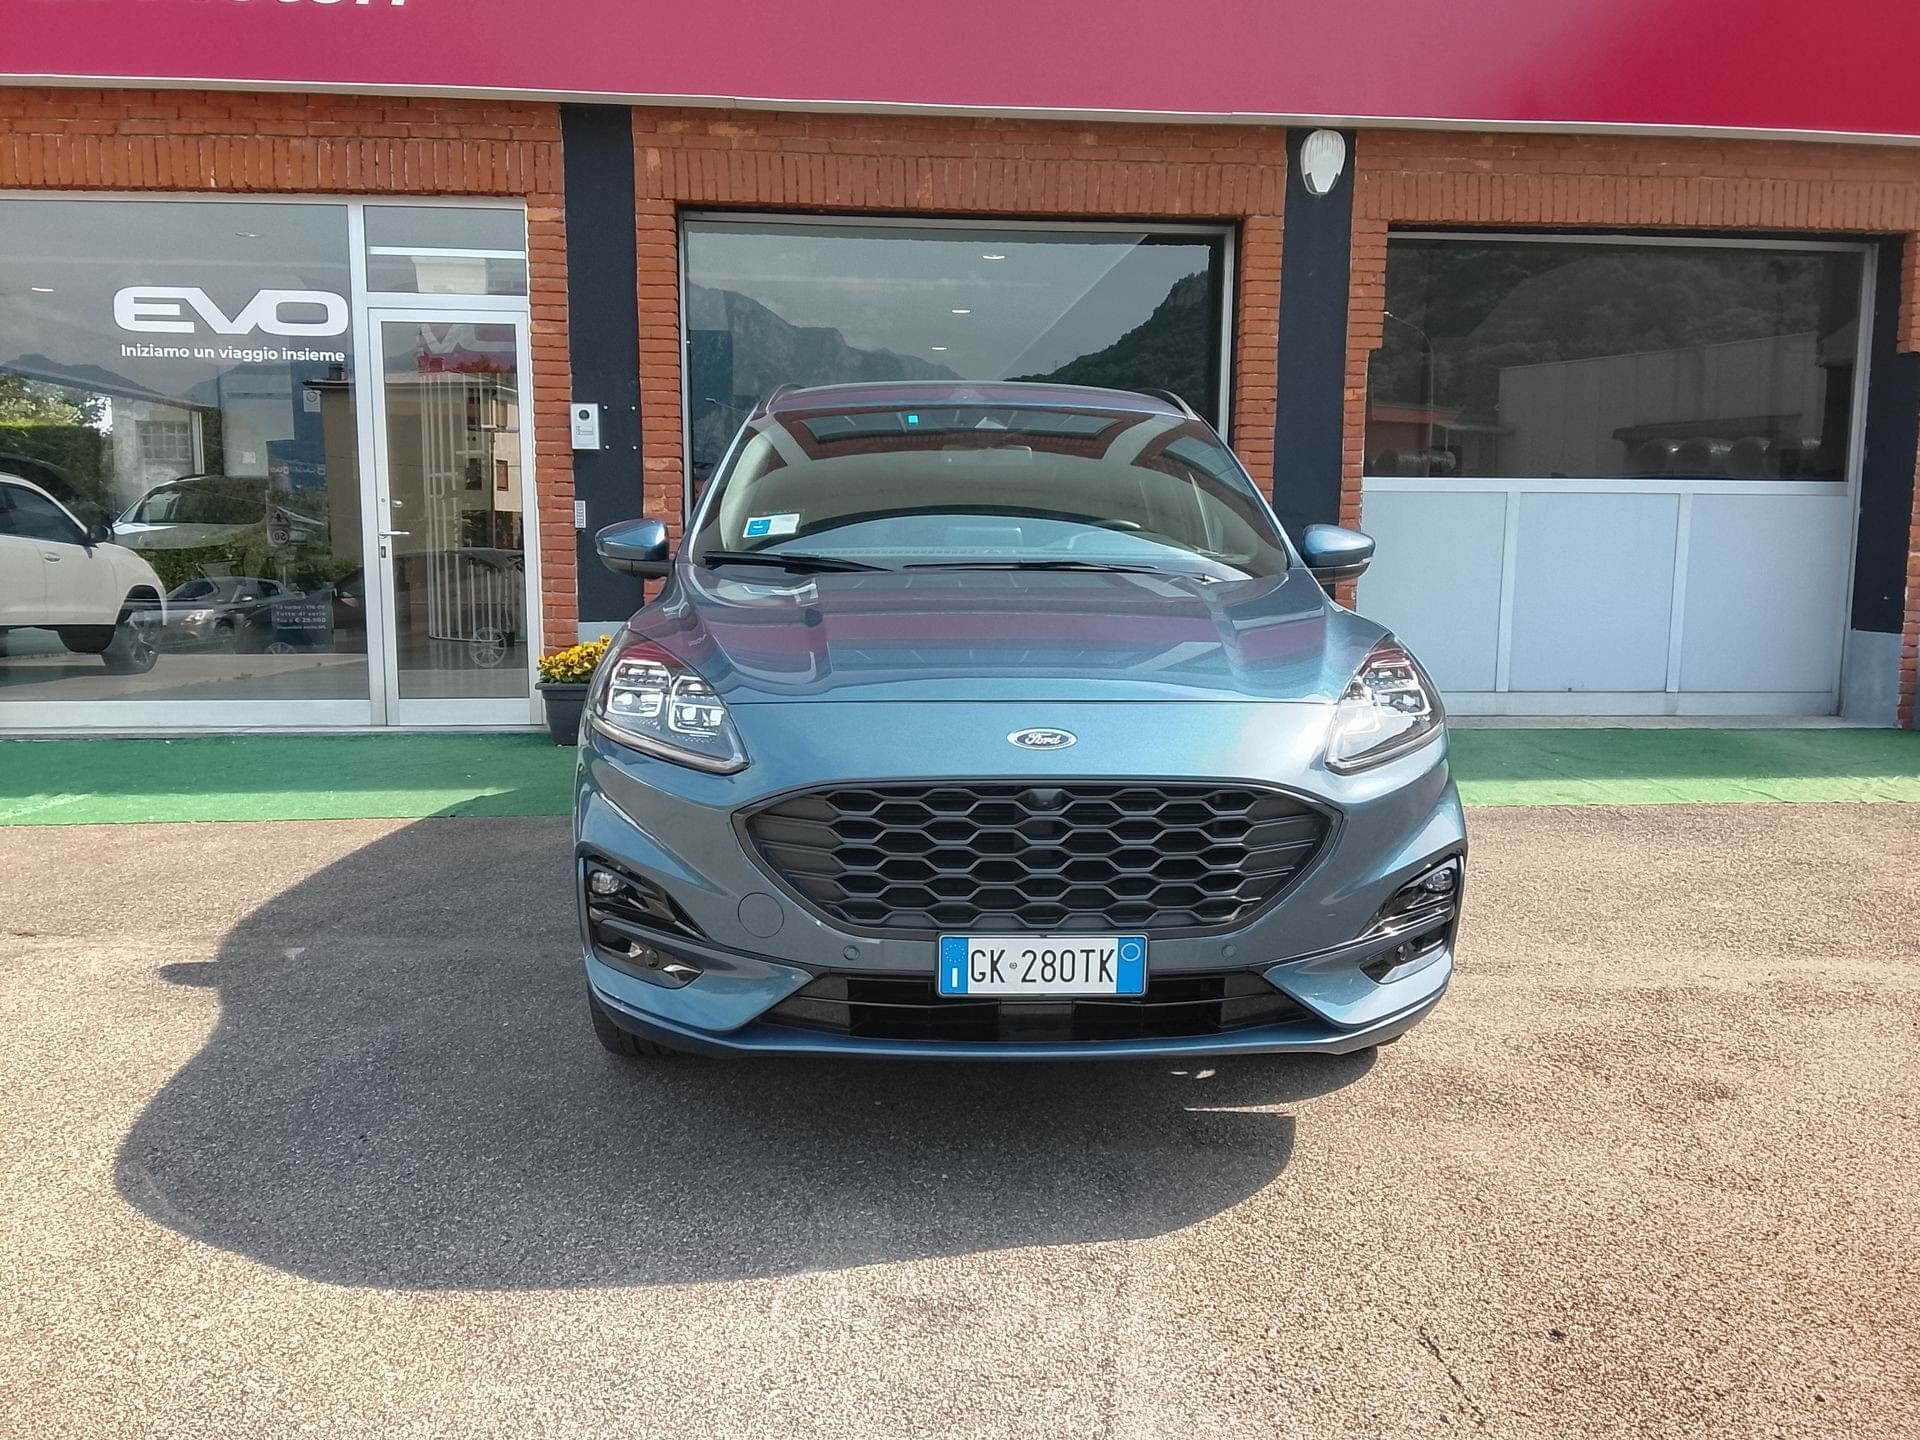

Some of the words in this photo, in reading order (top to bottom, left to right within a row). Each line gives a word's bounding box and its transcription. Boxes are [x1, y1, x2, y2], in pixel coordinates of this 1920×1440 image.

[113, 286, 349, 336] EVO
[121, 343, 190, 358] Iniziamo
[194, 347, 215, 358] un
[218, 345, 279, 362] viaggio
[281, 347, 345, 362] insieme
[1024, 732, 1062, 745] Ford
[970, 949, 1006, 983] GK
[1021, 949, 1115, 983] 280TK
